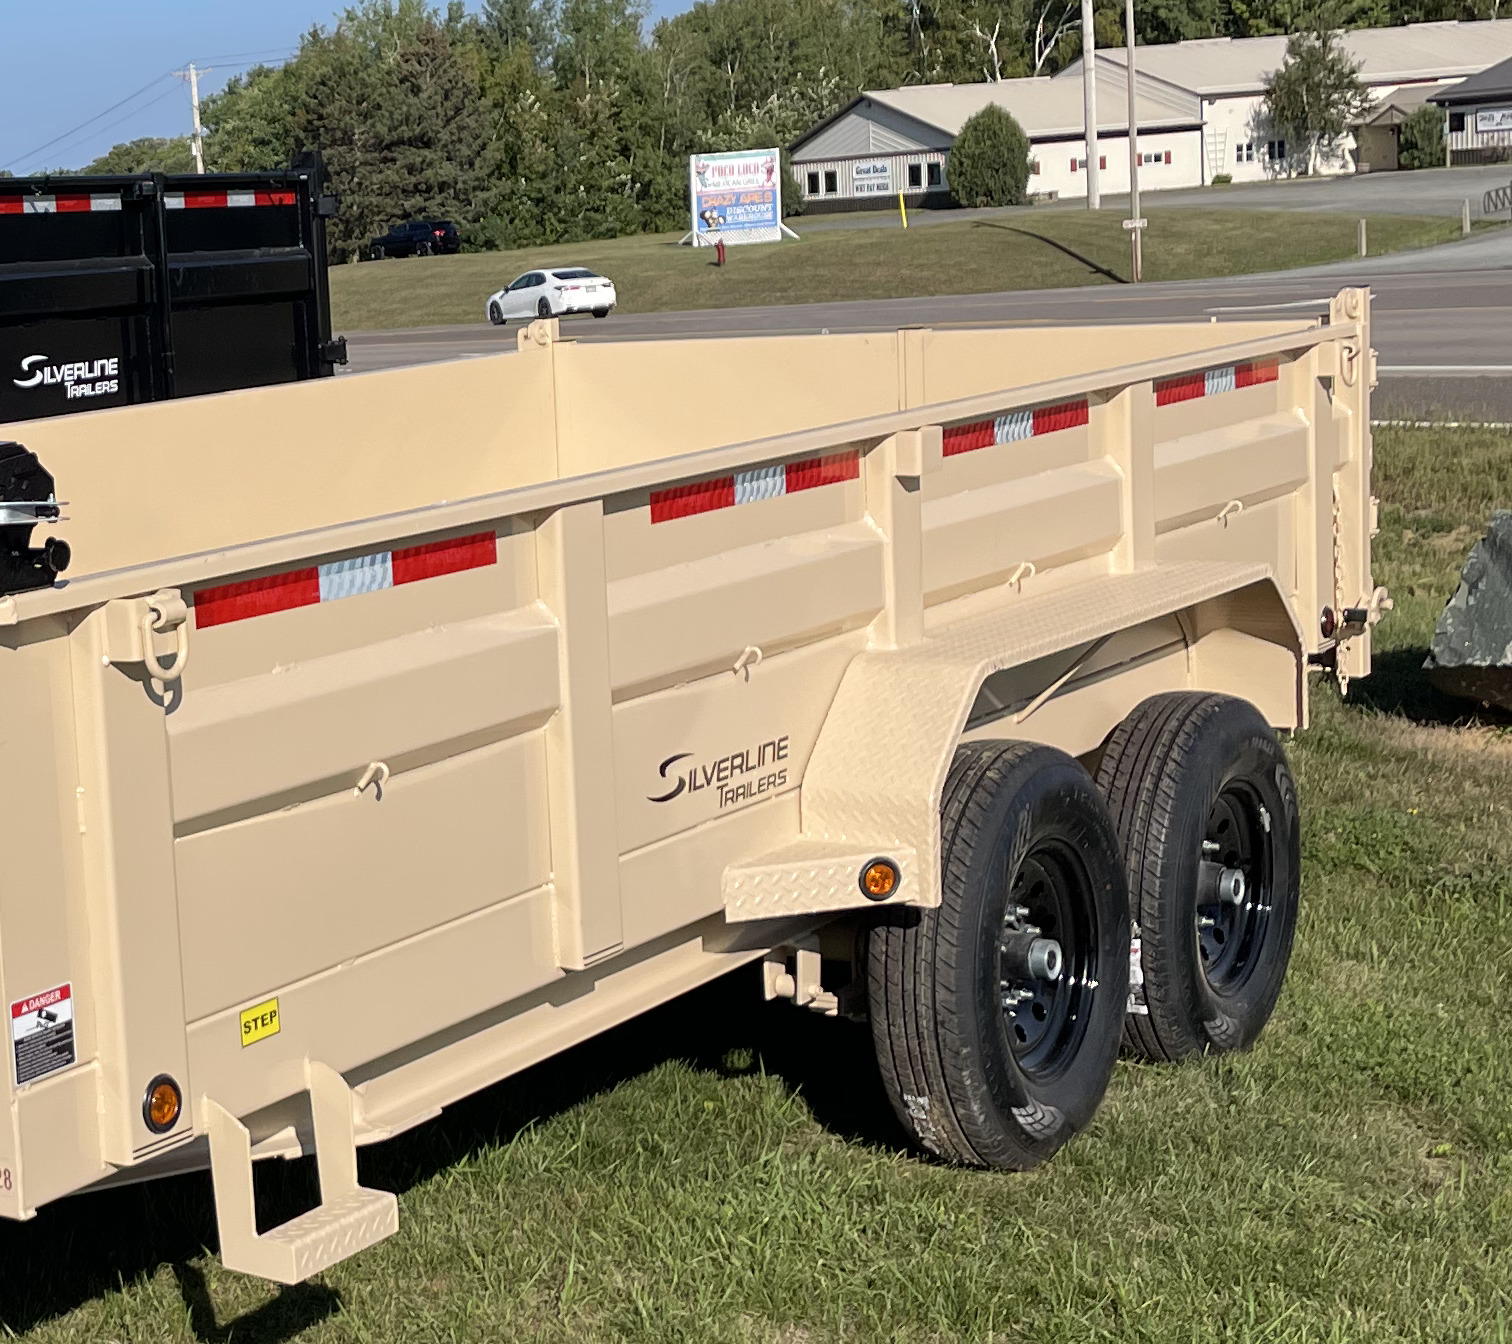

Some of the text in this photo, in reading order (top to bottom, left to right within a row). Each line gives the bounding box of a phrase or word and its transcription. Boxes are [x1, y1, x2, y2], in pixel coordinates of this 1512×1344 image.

[726, 204, 773, 215] DISCOUNT
[13, 354, 118, 388] SILVERLINE
[64, 380, 119, 399] TRAILERS
[646, 735, 789, 802] SILVERLINE
[716, 768, 788, 808] TRAILERS
[28, 989, 61, 1010] DANGER
[243, 1009, 277, 1035] STEP
